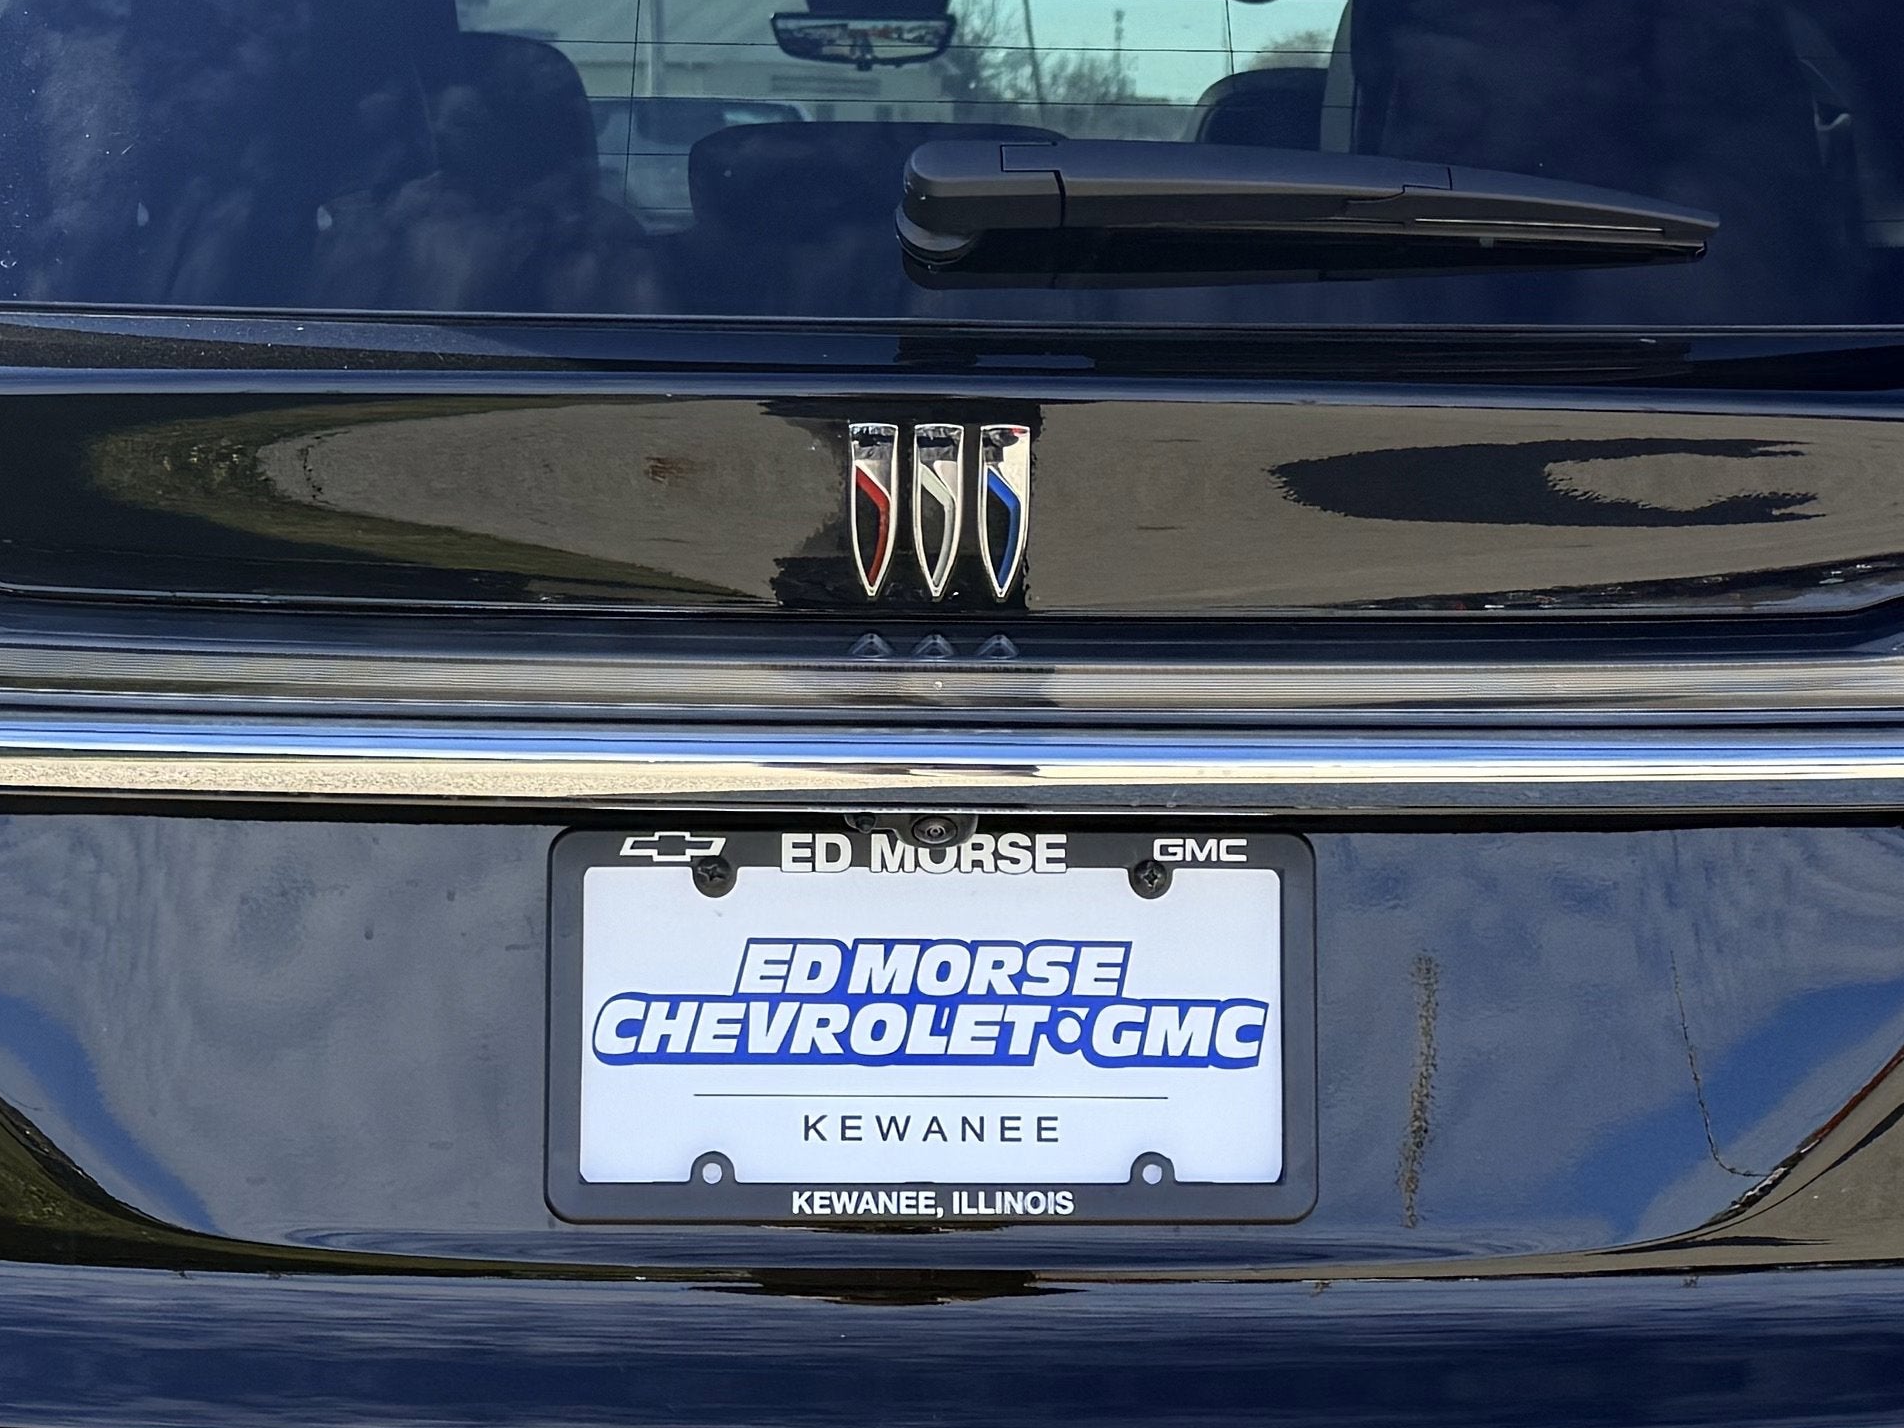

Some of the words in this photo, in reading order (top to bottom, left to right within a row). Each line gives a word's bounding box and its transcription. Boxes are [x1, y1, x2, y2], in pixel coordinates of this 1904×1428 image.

[781, 833, 852, 873] ED
[870, 833, 1068, 875] MORSE
[1153, 838, 1248, 862] GMC
[737, 943, 843, 994] ED
[846, 943, 1126, 997] MORSE
[802, 1114, 1060, 1143] KEWANEE
[791, 1190, 944, 1219] KEWANEE,
[952, 1190, 1075, 1215] ILLINOIS
